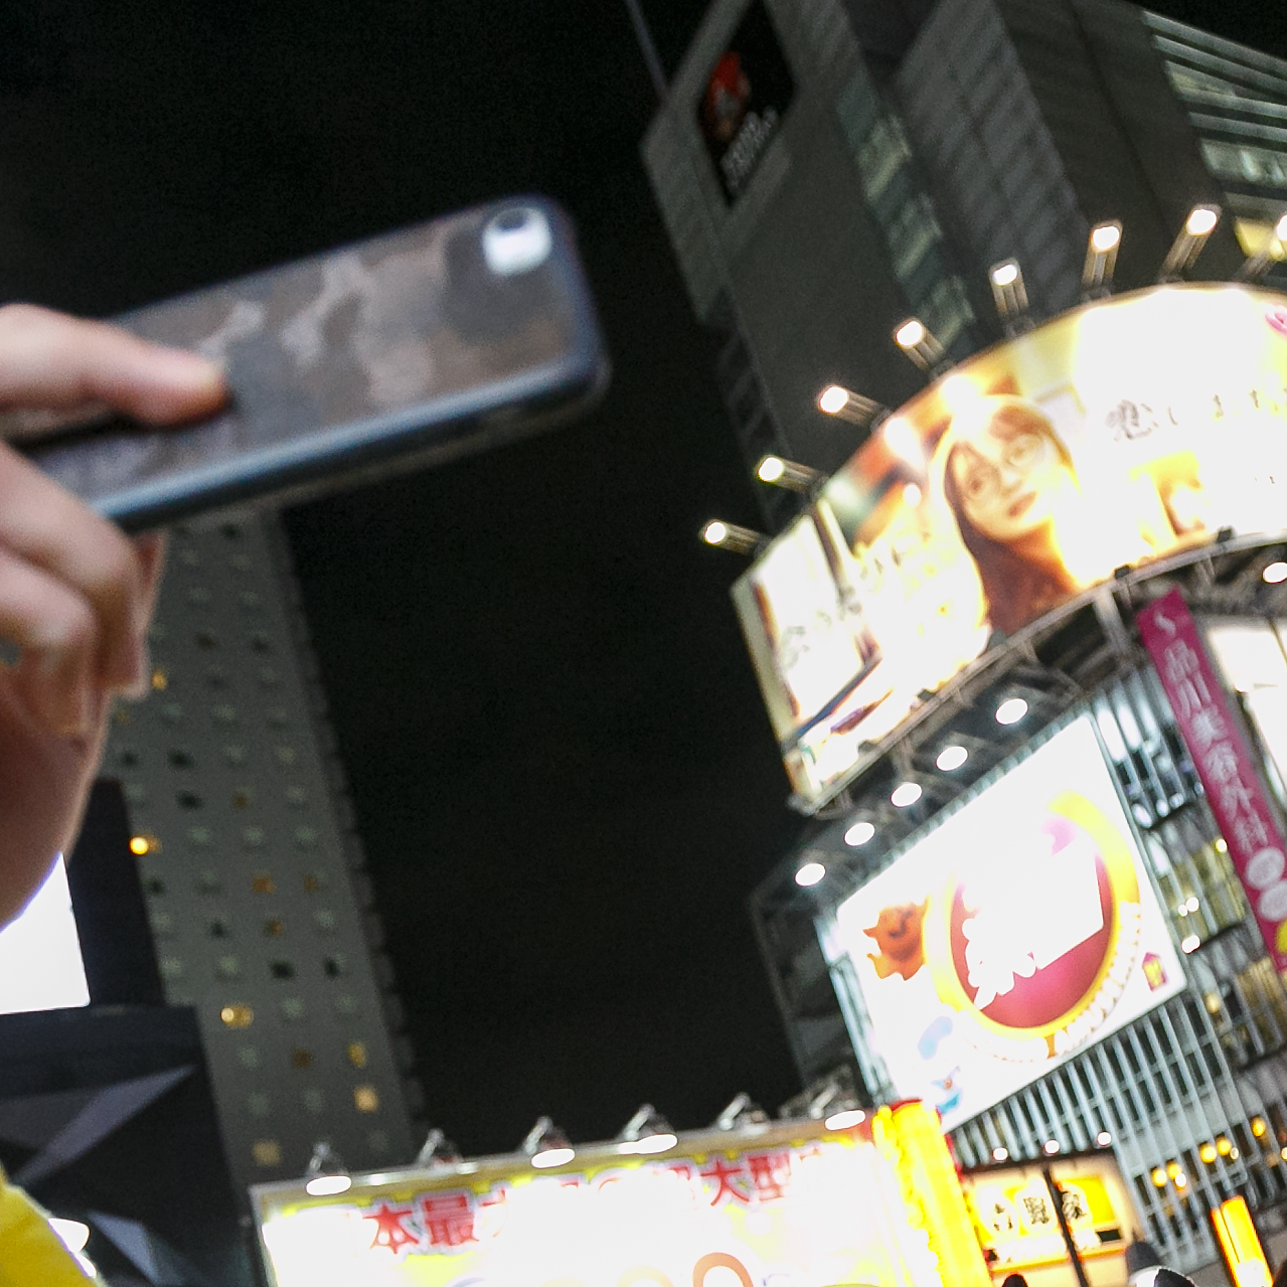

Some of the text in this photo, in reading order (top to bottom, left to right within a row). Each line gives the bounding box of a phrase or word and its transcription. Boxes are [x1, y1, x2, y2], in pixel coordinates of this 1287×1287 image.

[1163, 637, 1269, 857] 品川美容外科
